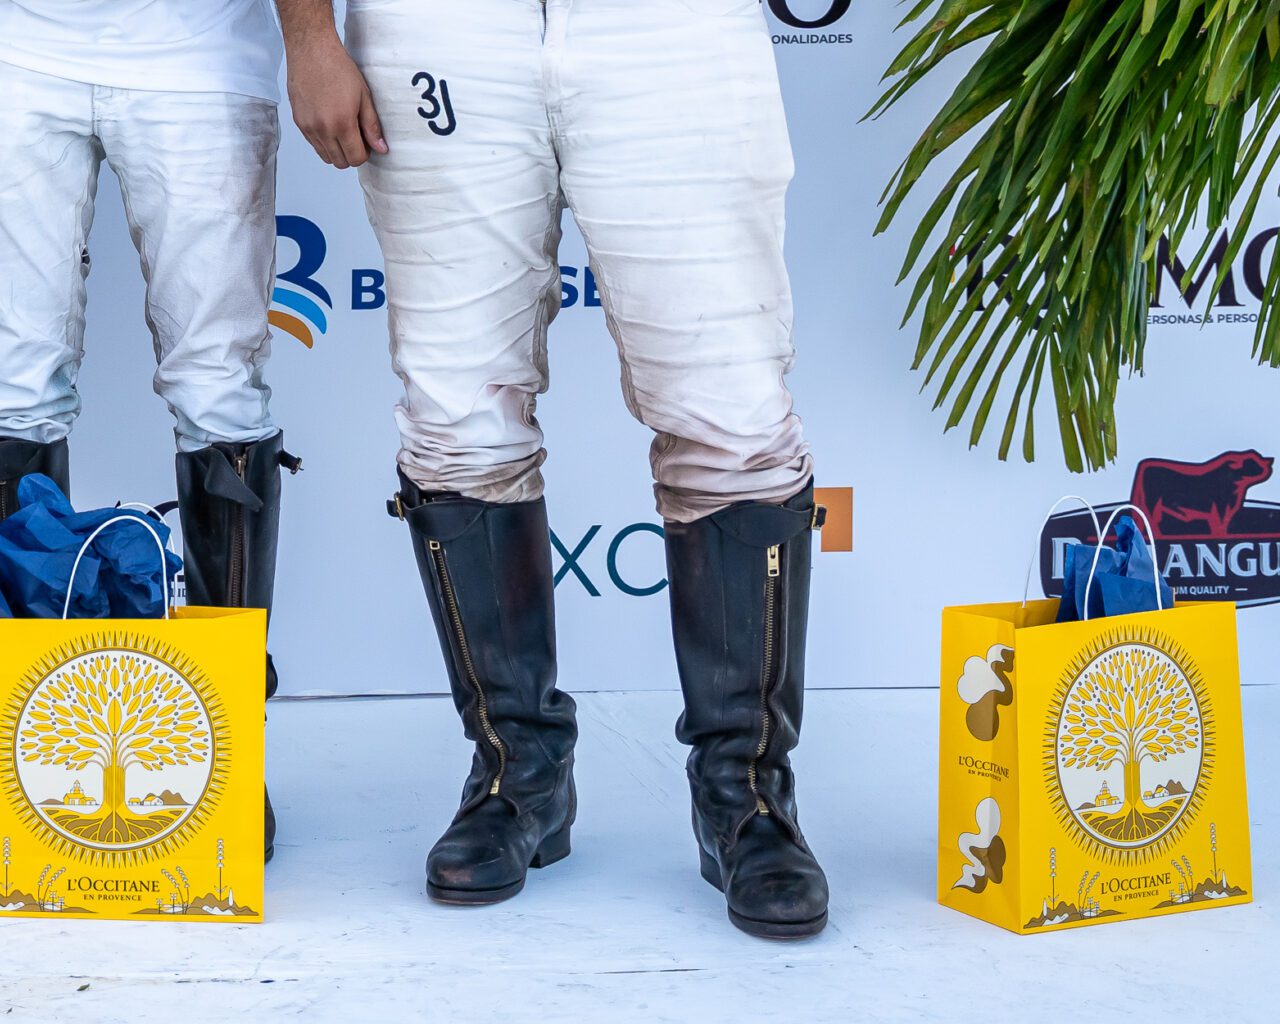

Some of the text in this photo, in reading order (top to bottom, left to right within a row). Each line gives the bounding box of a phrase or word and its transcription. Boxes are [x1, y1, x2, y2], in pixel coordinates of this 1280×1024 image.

[771, 33, 854, 45] ONALIDADES
[1146, 314, 1202, 325] ERSONAS
[1189, 585, 1230, 596] QUALITY
[67, 876, 160, 892] L'OCCITANE
[1101, 872, 1172, 895] L'OCCITANE
[97, 893, 142, 901] PROVENCE
[1124, 889, 1160, 900] PROVENCE
